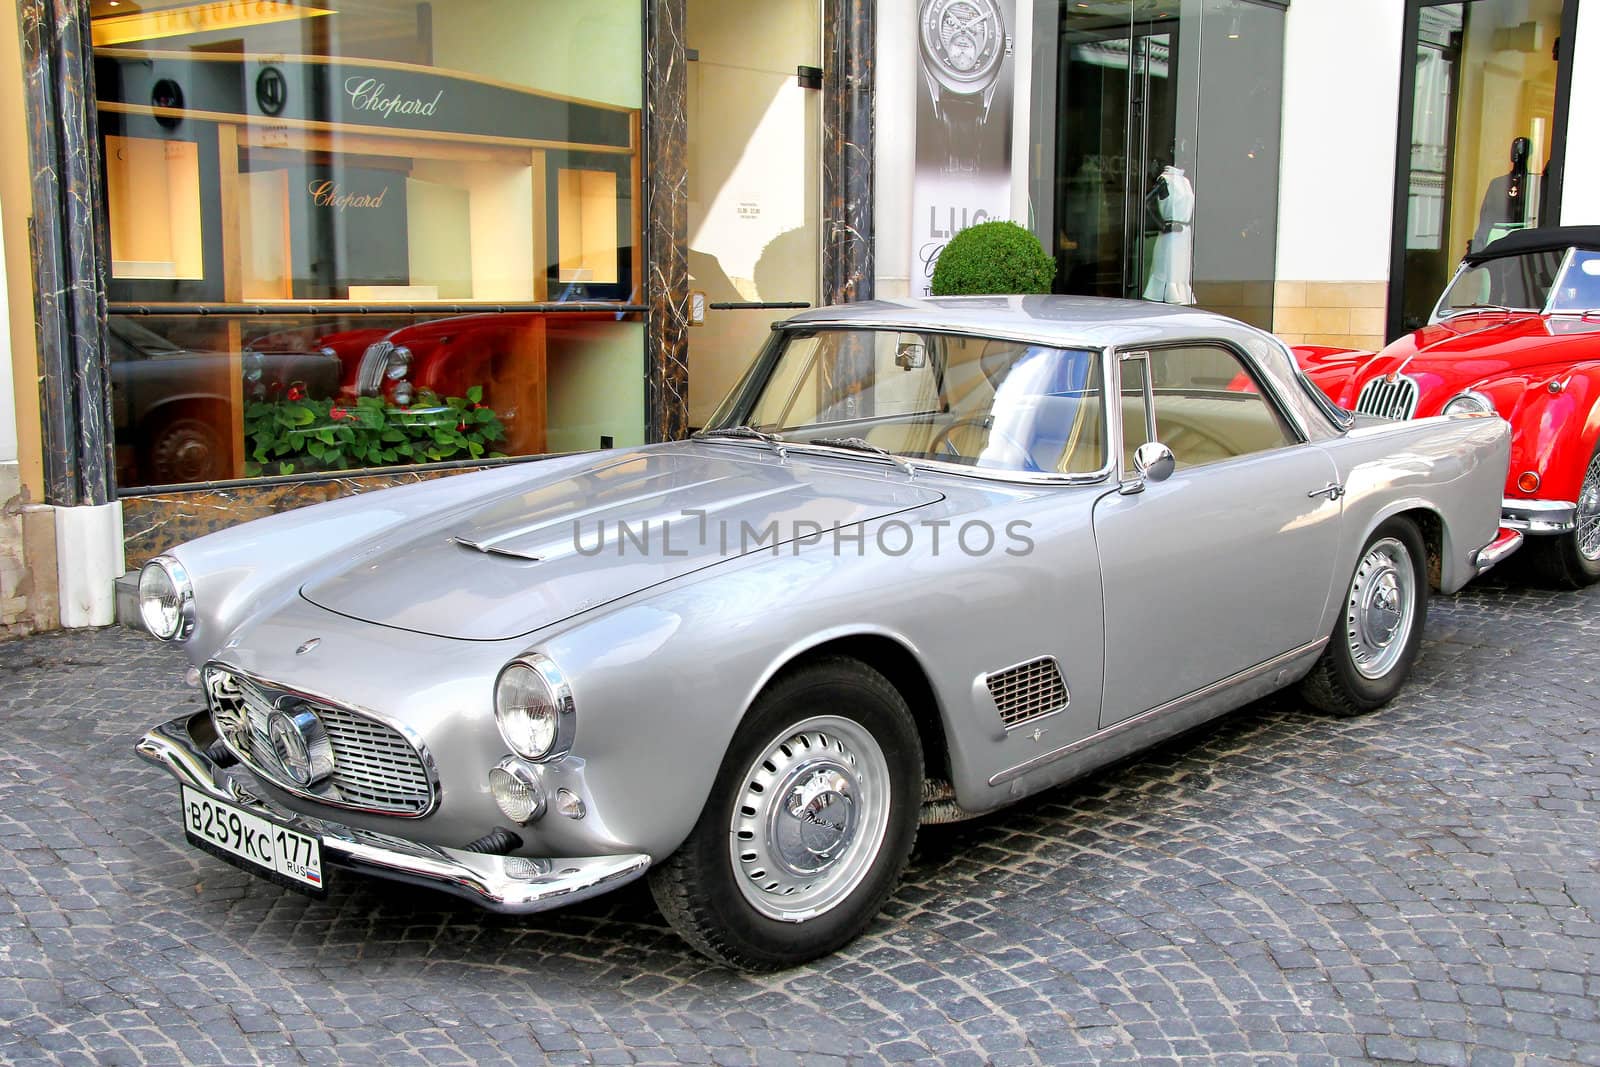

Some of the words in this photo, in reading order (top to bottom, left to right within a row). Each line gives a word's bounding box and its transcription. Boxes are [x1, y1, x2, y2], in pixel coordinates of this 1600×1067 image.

[344, 76, 443, 118] Chopard
[308, 179, 388, 213] Chopard
[276, 831, 312, 866] 177
[287, 862, 306, 876] RUS
